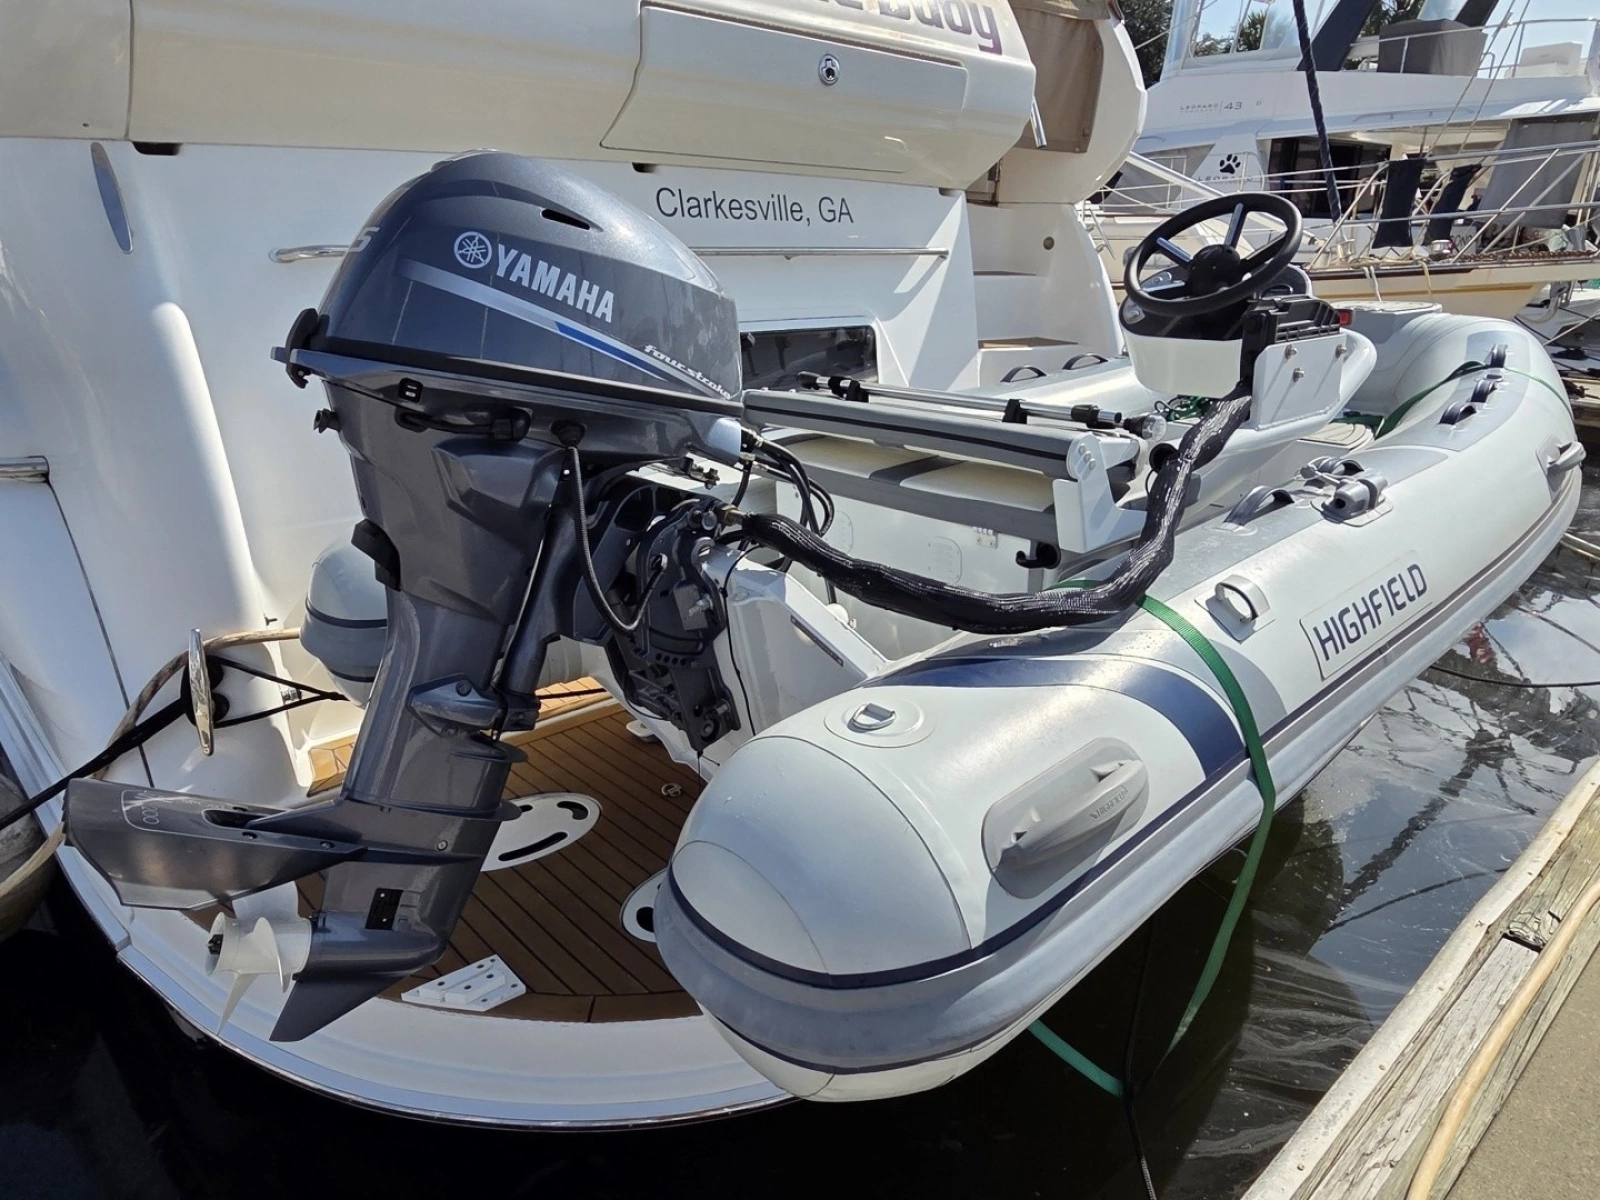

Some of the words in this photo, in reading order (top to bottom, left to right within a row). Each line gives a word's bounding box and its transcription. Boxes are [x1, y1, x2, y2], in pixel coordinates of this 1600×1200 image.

[655, 186, 811, 227] Clarkesville,
[818, 196, 854, 223] GA
[496, 243, 615, 323] YAMAHA
[1312, 563, 1428, 661] HIGHFIELD
